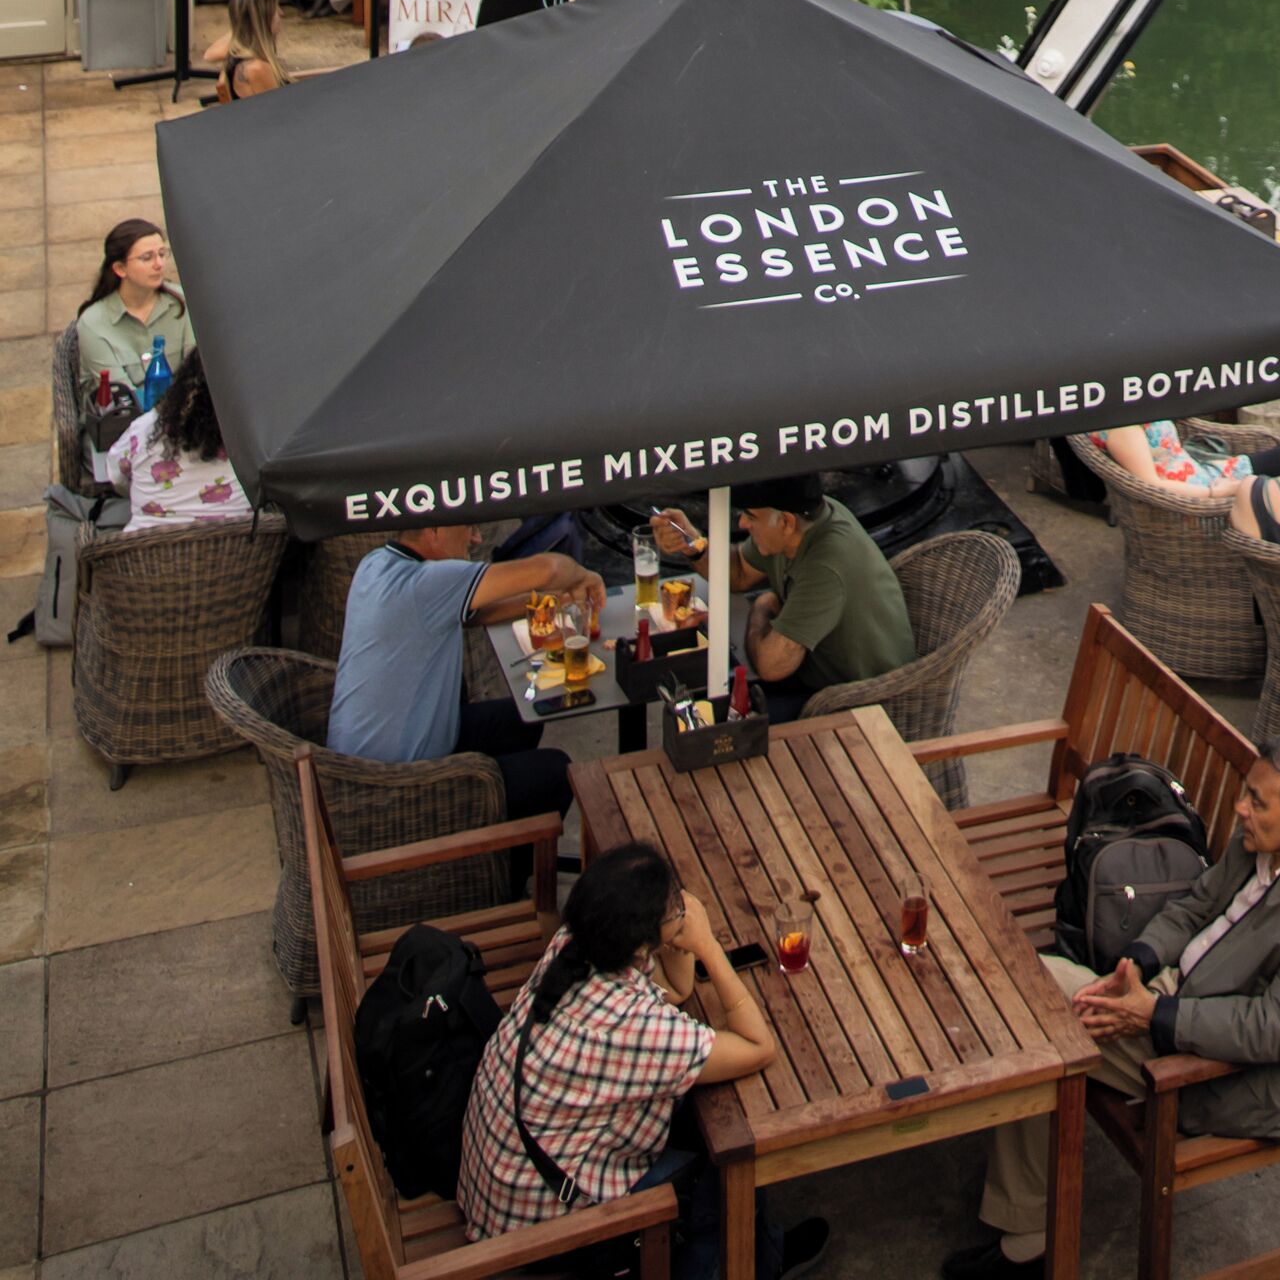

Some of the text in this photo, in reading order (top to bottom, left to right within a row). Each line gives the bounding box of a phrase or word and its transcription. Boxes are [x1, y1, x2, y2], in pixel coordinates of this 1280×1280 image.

[763, 175, 829, 198] THE
[661, 189, 953, 249] LONDON
[672, 226, 969, 289] ESSENCE
[345, 459, 585, 522] EXQUISITE
[603, 432, 761, 483] MIXERS
[777, 412, 891, 454] FROM
[908, 381, 1106, 436] DISTILLED
